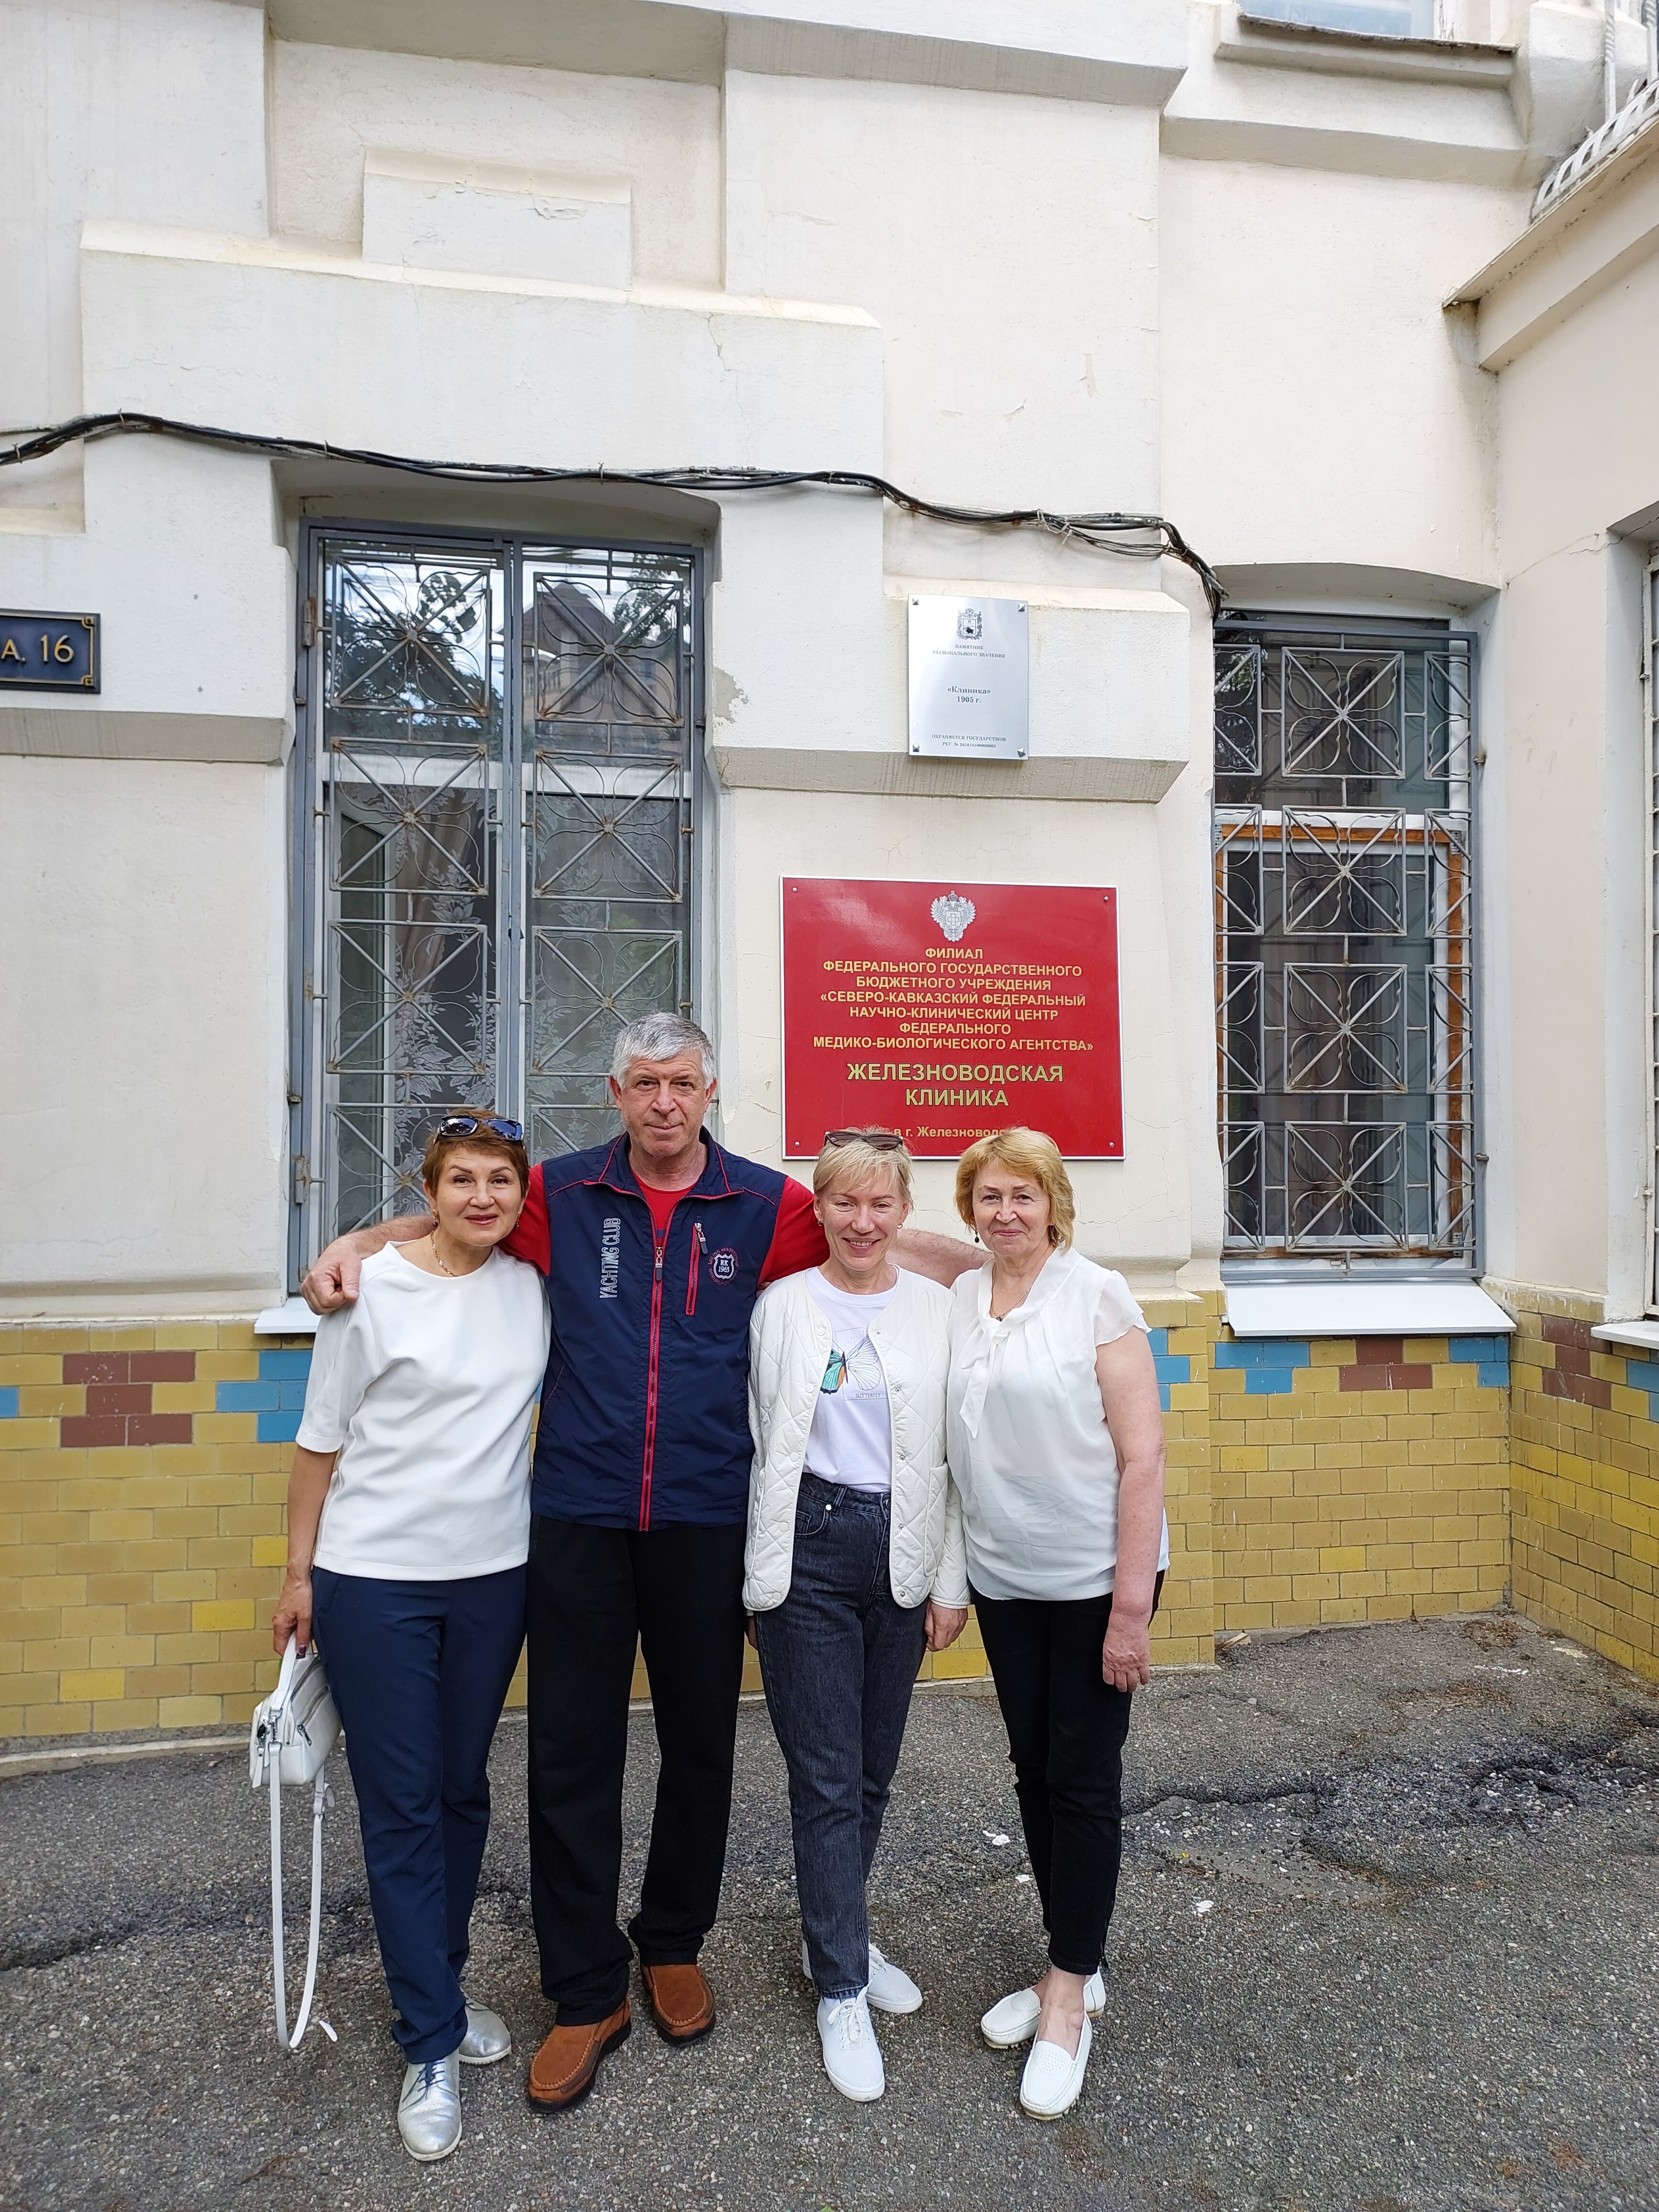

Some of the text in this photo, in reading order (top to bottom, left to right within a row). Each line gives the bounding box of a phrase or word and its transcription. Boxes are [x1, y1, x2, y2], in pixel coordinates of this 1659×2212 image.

[41, 634, 74, 663] 16
[947, 686, 991, 695] «Клиника»
[925, 947, 983, 959] ФИЛИАЛ
[823, 960, 1082, 976] ФЕДЕРАЛЬНОГО ГОСУДАРСТВЕННОГО
[856, 976, 1051, 992] БЮДЖЕТНОГО УЧРЕЖДЕНИЯ
[820, 991, 1086, 1006] «СЕВЕРО-КАВКАЗСКИЙ ФЕДЕРАЛЬНЫЙ
[850, 1006, 1059, 1022] НАУЧНО-КЛИНИЧЕСКИЙ ЦЕНТР
[899, 1022, 1011, 1036] ФЕДЕРАЛЬНОГО
[814, 1036, 1094, 1051] МЕДИКО-БИОЛОГИЧЕСКОГО АГЕНТСТВА»
[847, 1063, 1063, 1085] ЖЕЛЕЗНОВОДСКАЯ
[906, 1089, 1009, 1106] КЛИНИКА
[905, 1128, 913, 1138] г.
[599, 1217, 621, 1299] YACHTING CLUB
